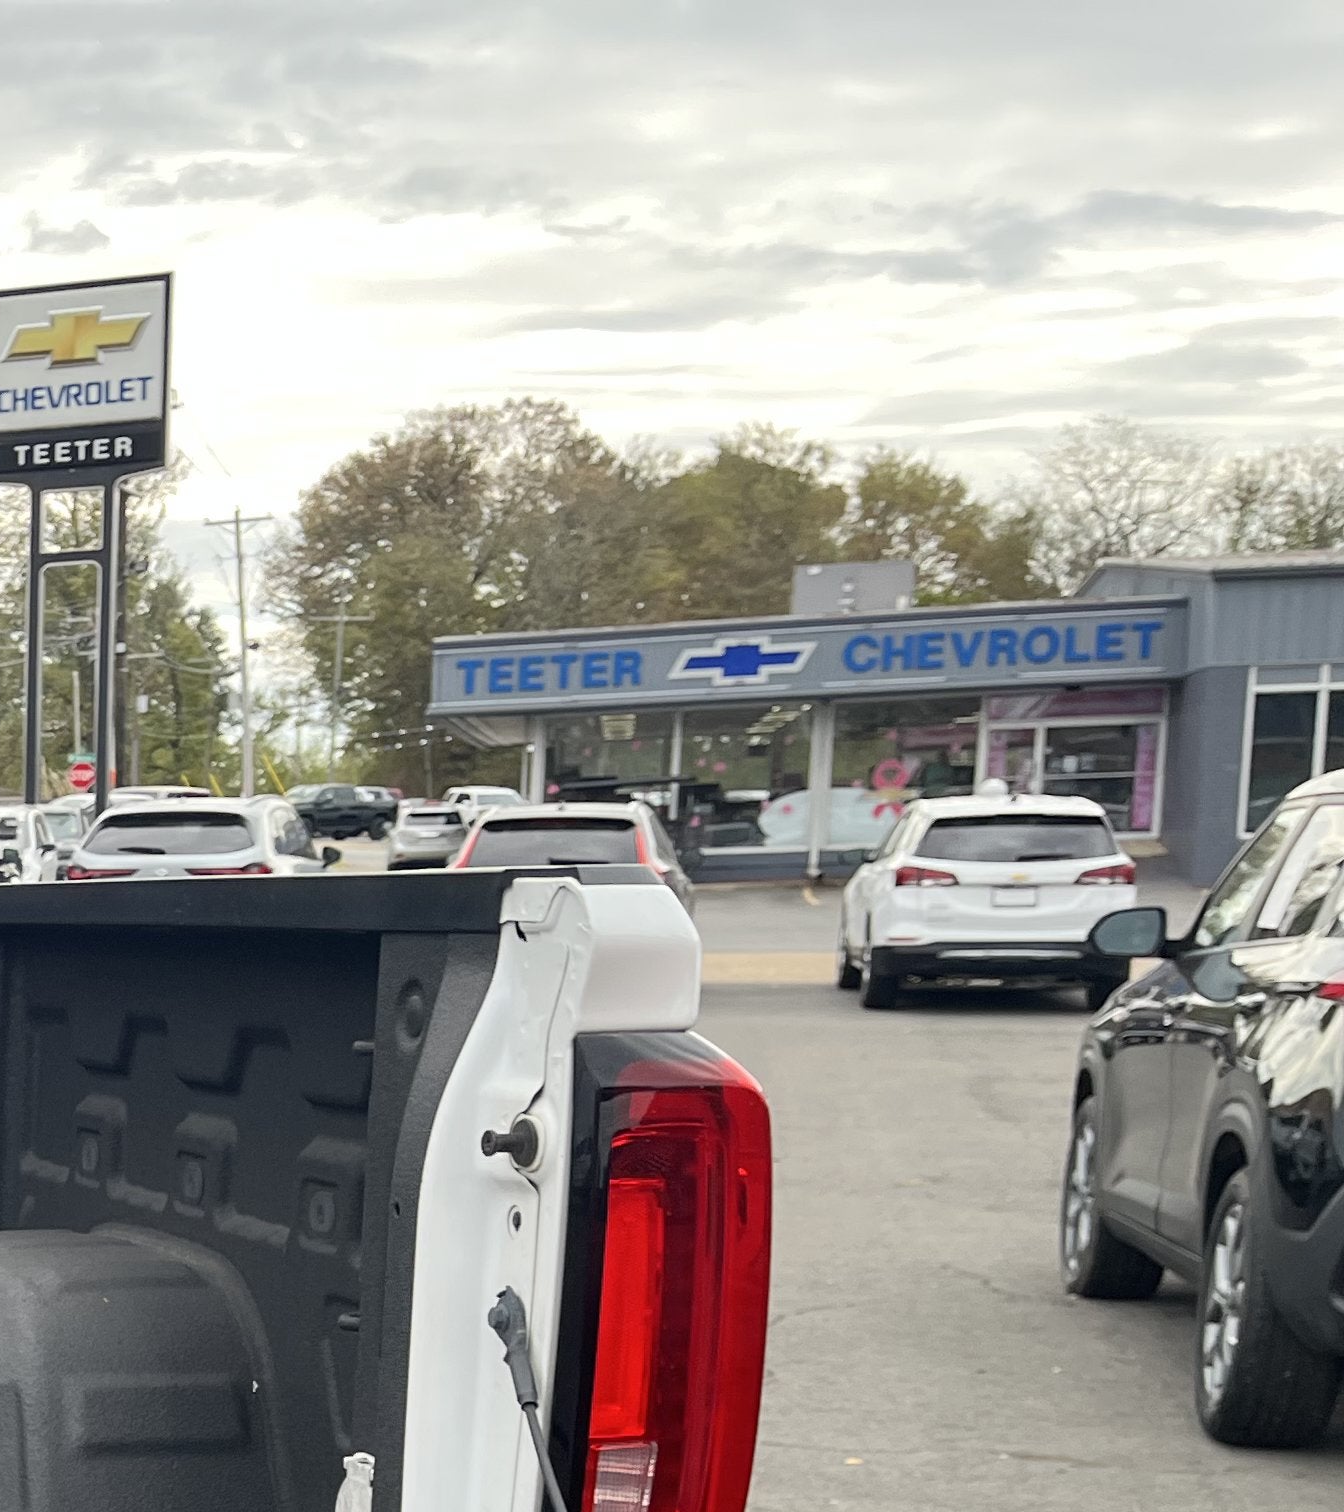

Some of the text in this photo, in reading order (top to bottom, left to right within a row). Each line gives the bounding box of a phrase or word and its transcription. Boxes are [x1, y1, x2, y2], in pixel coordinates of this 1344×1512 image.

[13, 436, 133, 466] TEETER
[456, 621, 1164, 694] TEETER CHEVROLET
